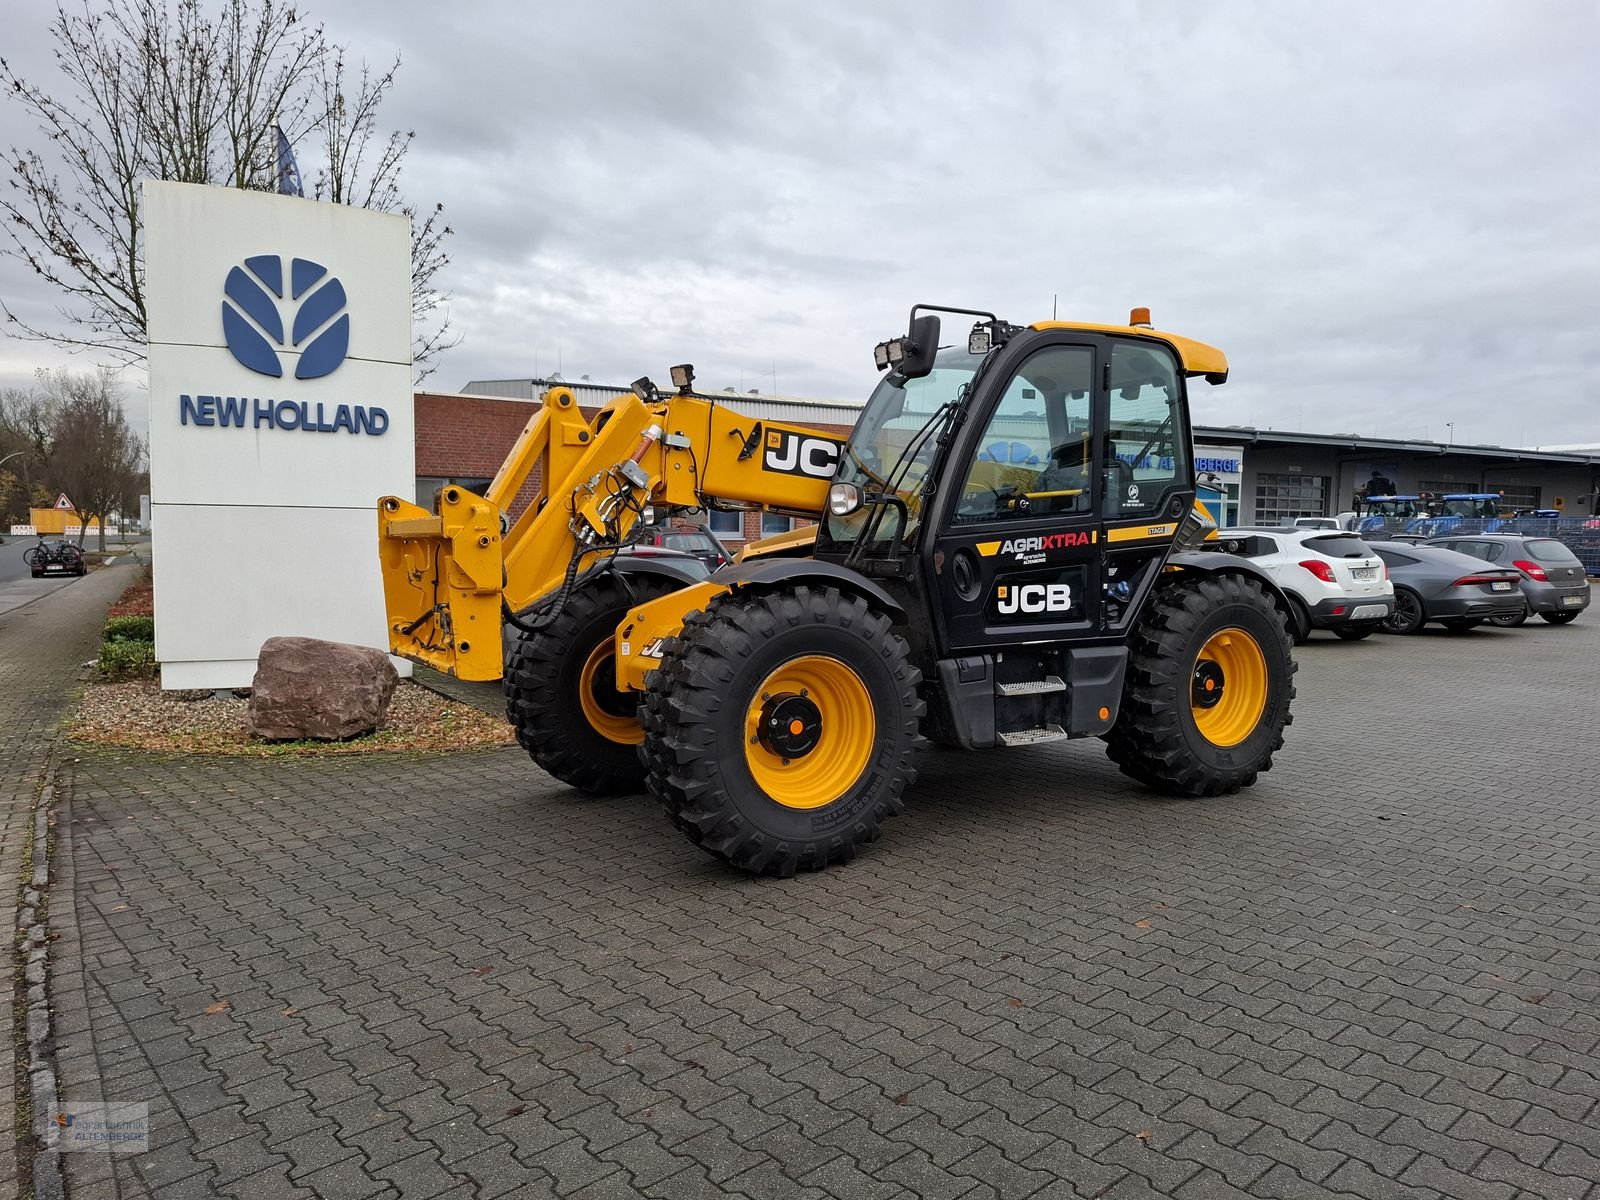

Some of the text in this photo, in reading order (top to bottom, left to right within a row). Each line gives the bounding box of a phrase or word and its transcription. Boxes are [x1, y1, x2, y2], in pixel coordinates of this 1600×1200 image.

[179, 394, 390, 436] NEW HOLLAND
[766, 434, 845, 478] JC
[1000, 531, 1090, 555] AGRIXTRA
[997, 584, 1072, 614] JCB
[641, 639, 664, 658] JC
